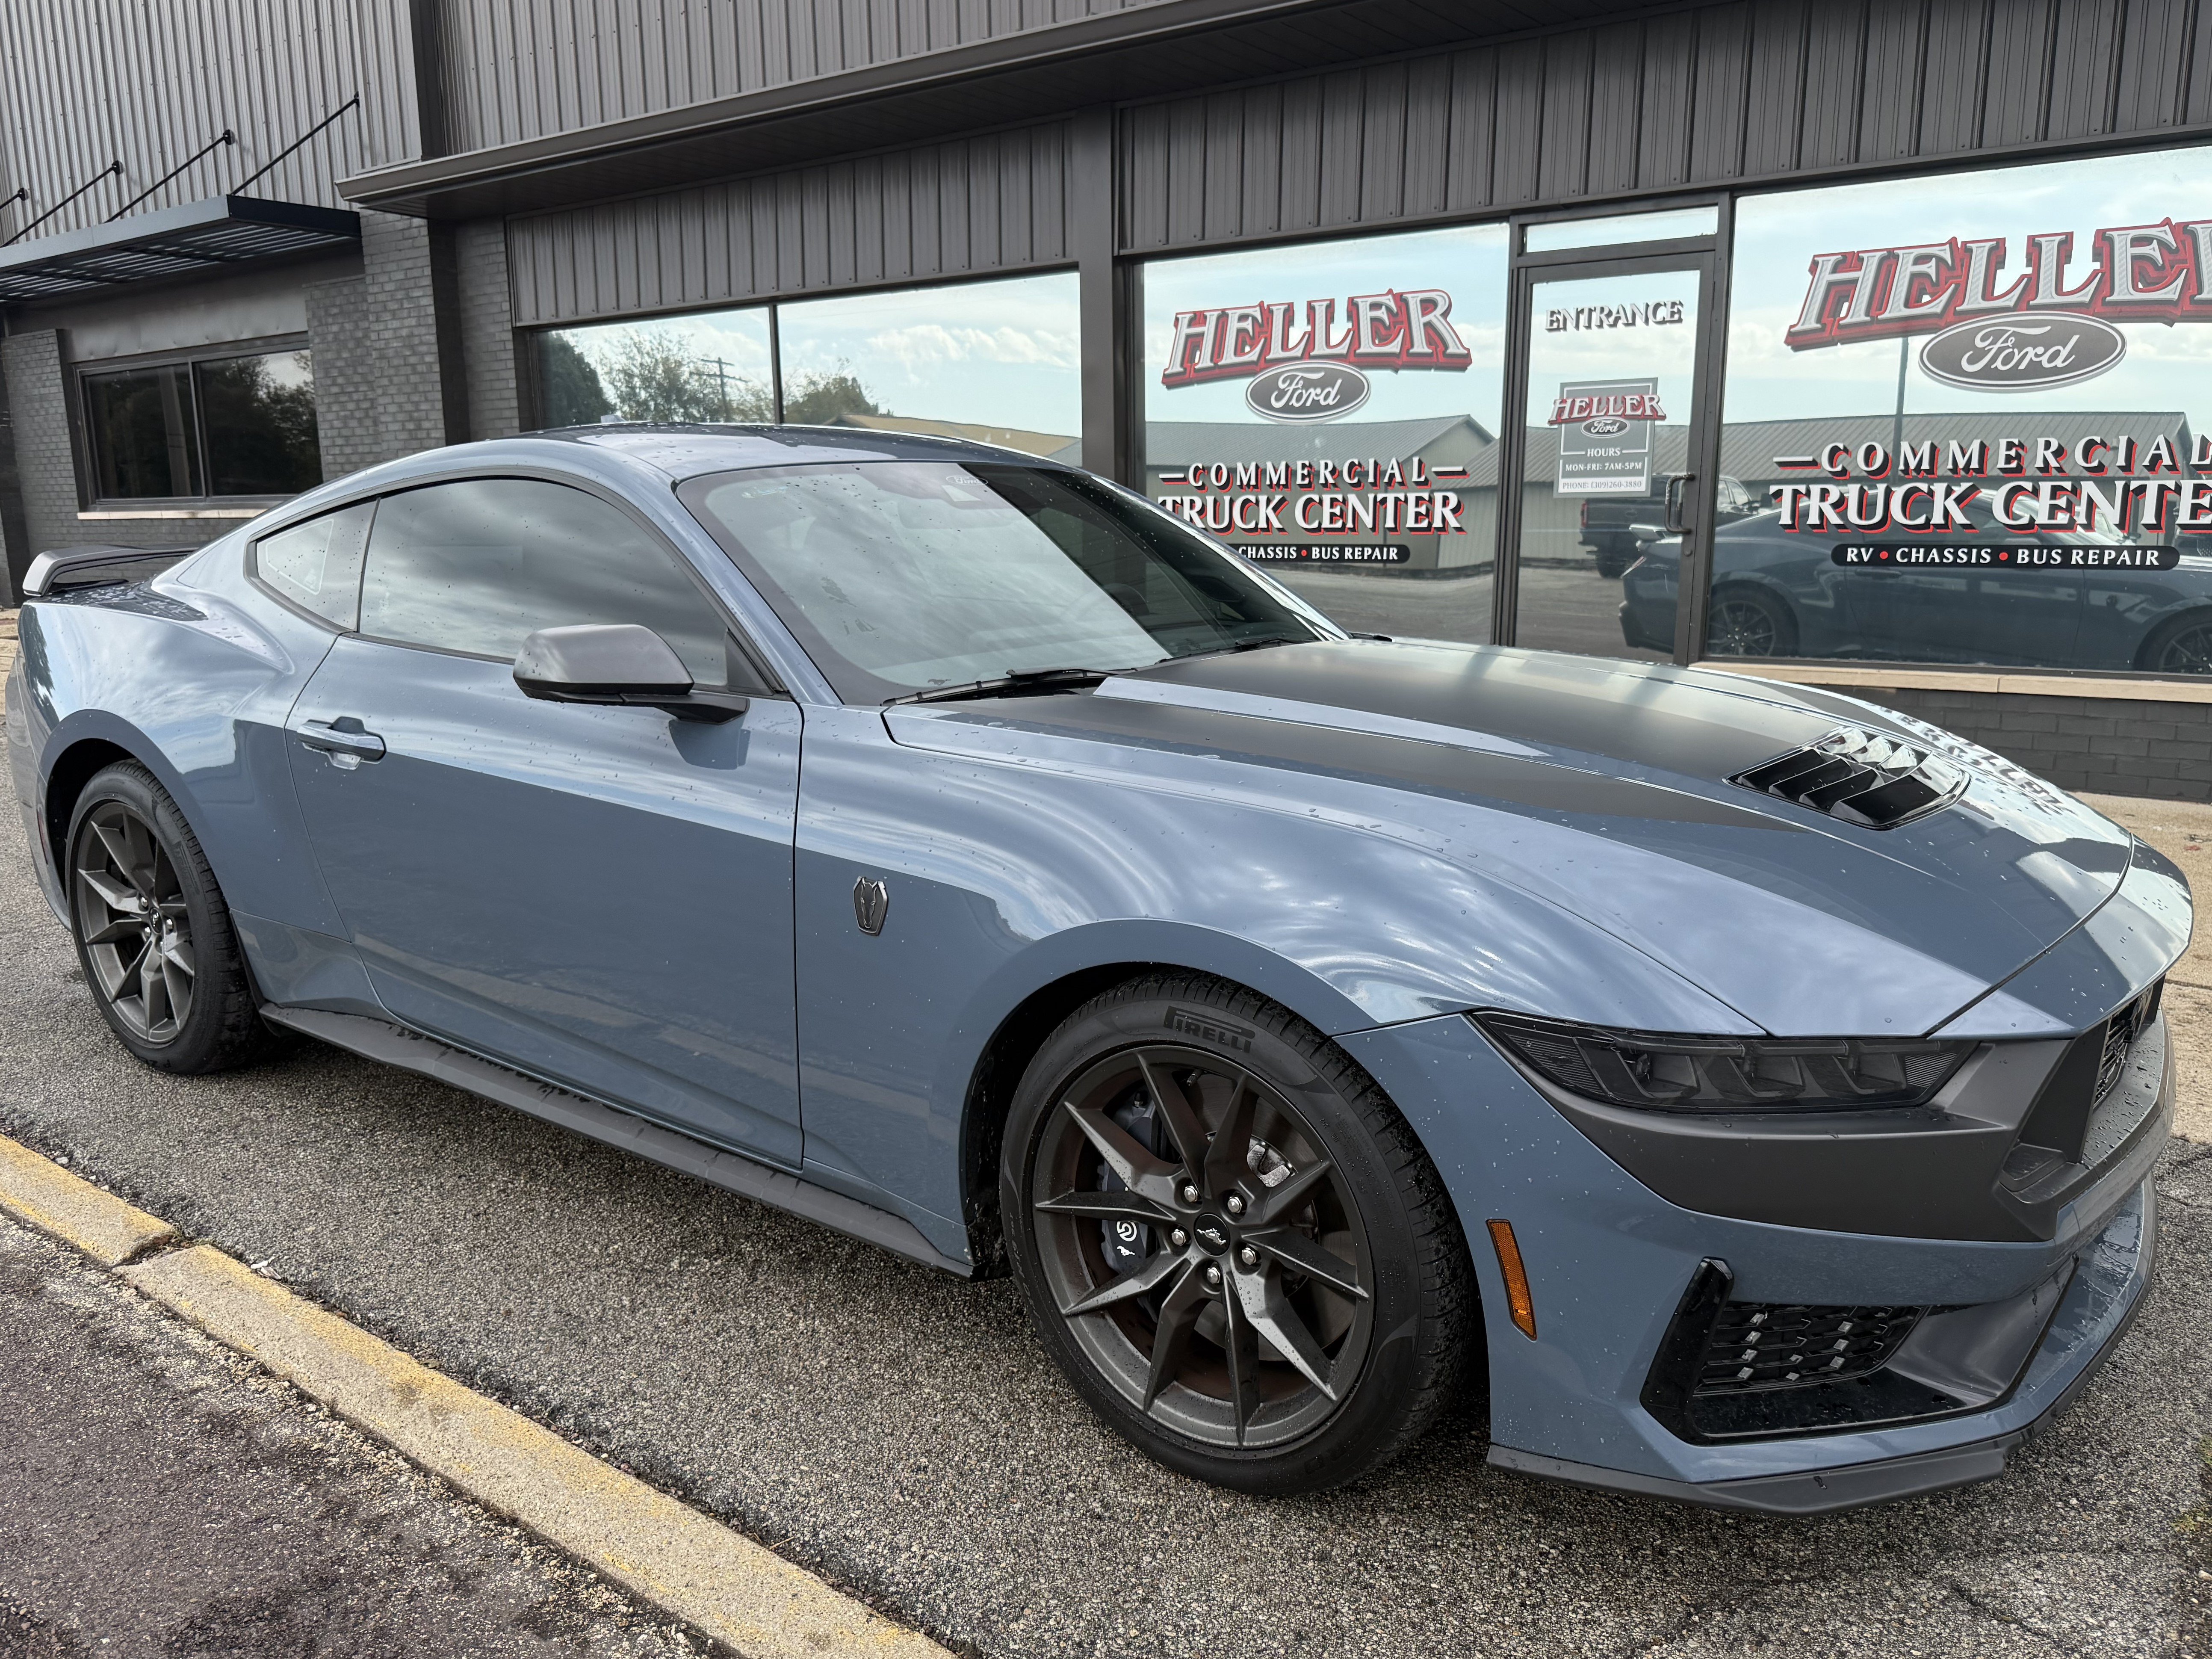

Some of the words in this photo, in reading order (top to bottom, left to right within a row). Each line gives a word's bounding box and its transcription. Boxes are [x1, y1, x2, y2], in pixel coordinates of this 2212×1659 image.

[1786, 217, 2212, 344] HELLE
[1545, 299, 1683, 332] ENTRANCE
[1162, 288, 1472, 383] HELLER
[1961, 325, 2080, 372] Ford
[1270, 371, 1343, 408] Ford
[1548, 394, 1666, 423] HELLER
[1591, 419, 1620, 433] Ford
[1565, 463, 1602, 471] MON-FRI:
[1604, 461, 1642, 470] 7AM-5PM
[1587, 447, 1621, 457] HOURS
[1821, 434, 2212, 476] COMMERCIAL
[1188, 456, 1429, 489] COMMERCIAL
[1158, 494, 1287, 532] TRUCK
[1295, 492, 1464, 532] CENTER
[1769, 482, 1980, 530] TRUCK
[1312, 547, 1340, 559] BUS
[1344, 547, 1398, 560] REPAIR
[1846, 547, 1875, 562] RV
[1896, 548, 1991, 564] CHASSIS
[2017, 548, 2061, 565] BUS
[2071, 549, 2159, 566] REPAIR
[1164, 1006, 1255, 1053] PIRELLI
